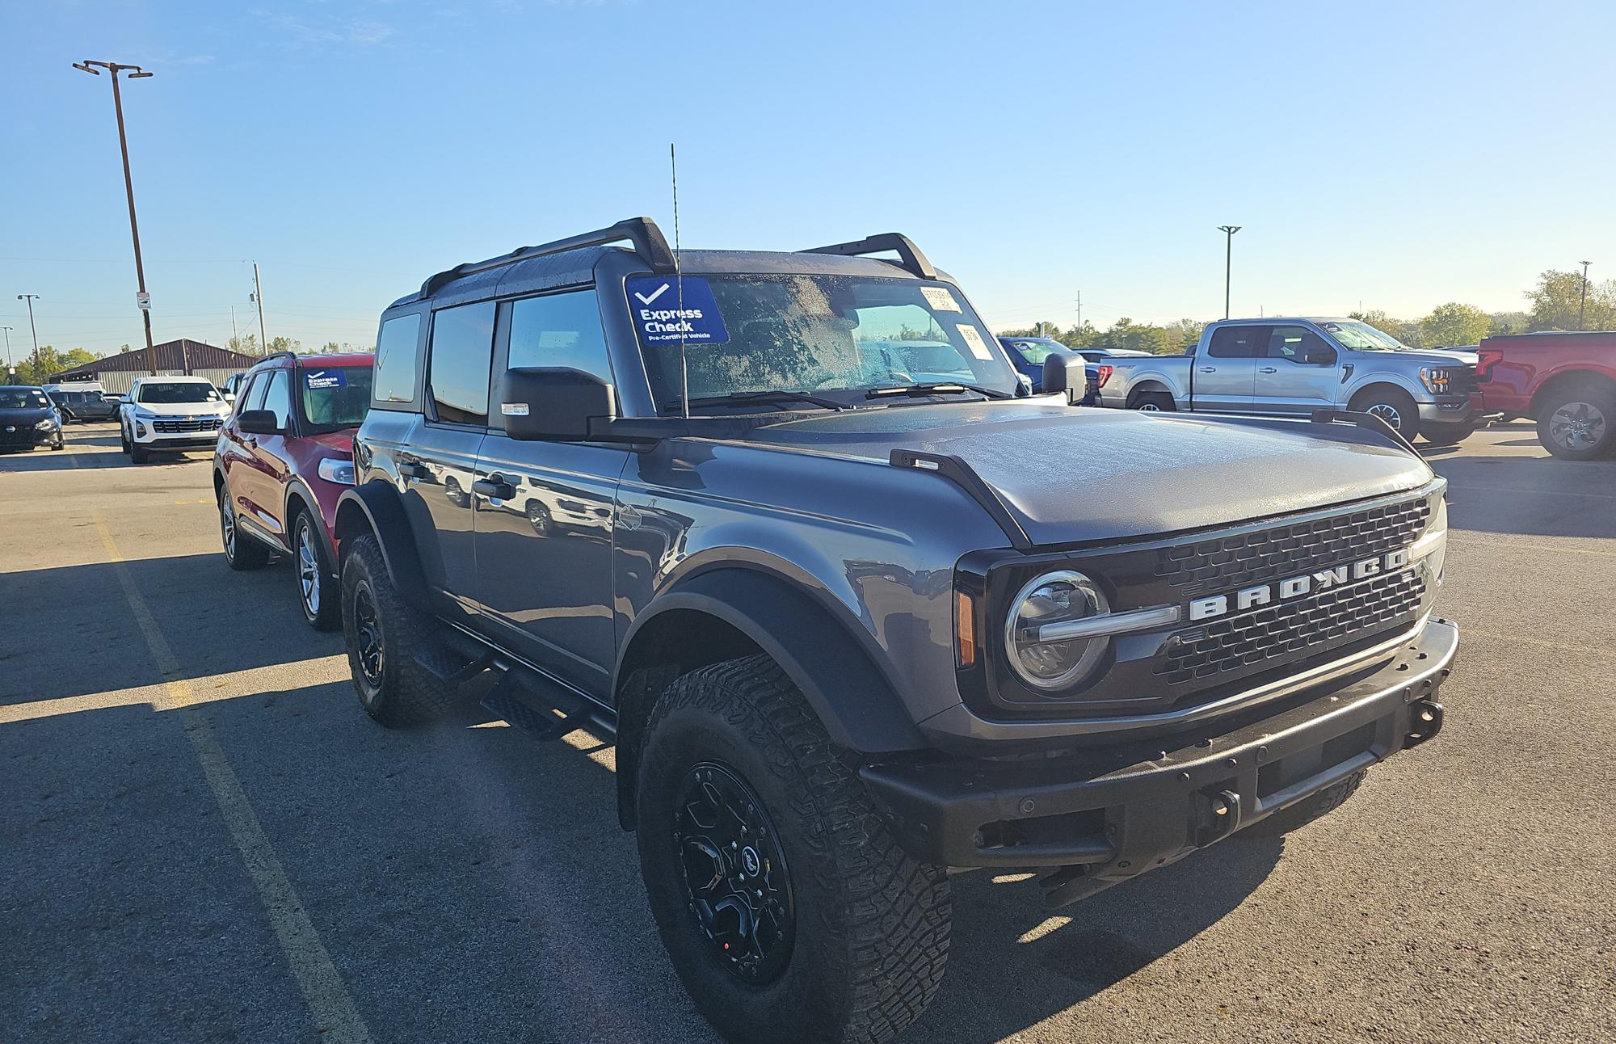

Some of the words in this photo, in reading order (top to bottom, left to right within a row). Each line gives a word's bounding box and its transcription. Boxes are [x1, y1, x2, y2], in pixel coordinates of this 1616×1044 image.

[640, 309, 703, 321] Express
[645, 320, 694, 332] Check
[1190, 550, 1408, 621] BRONCO
